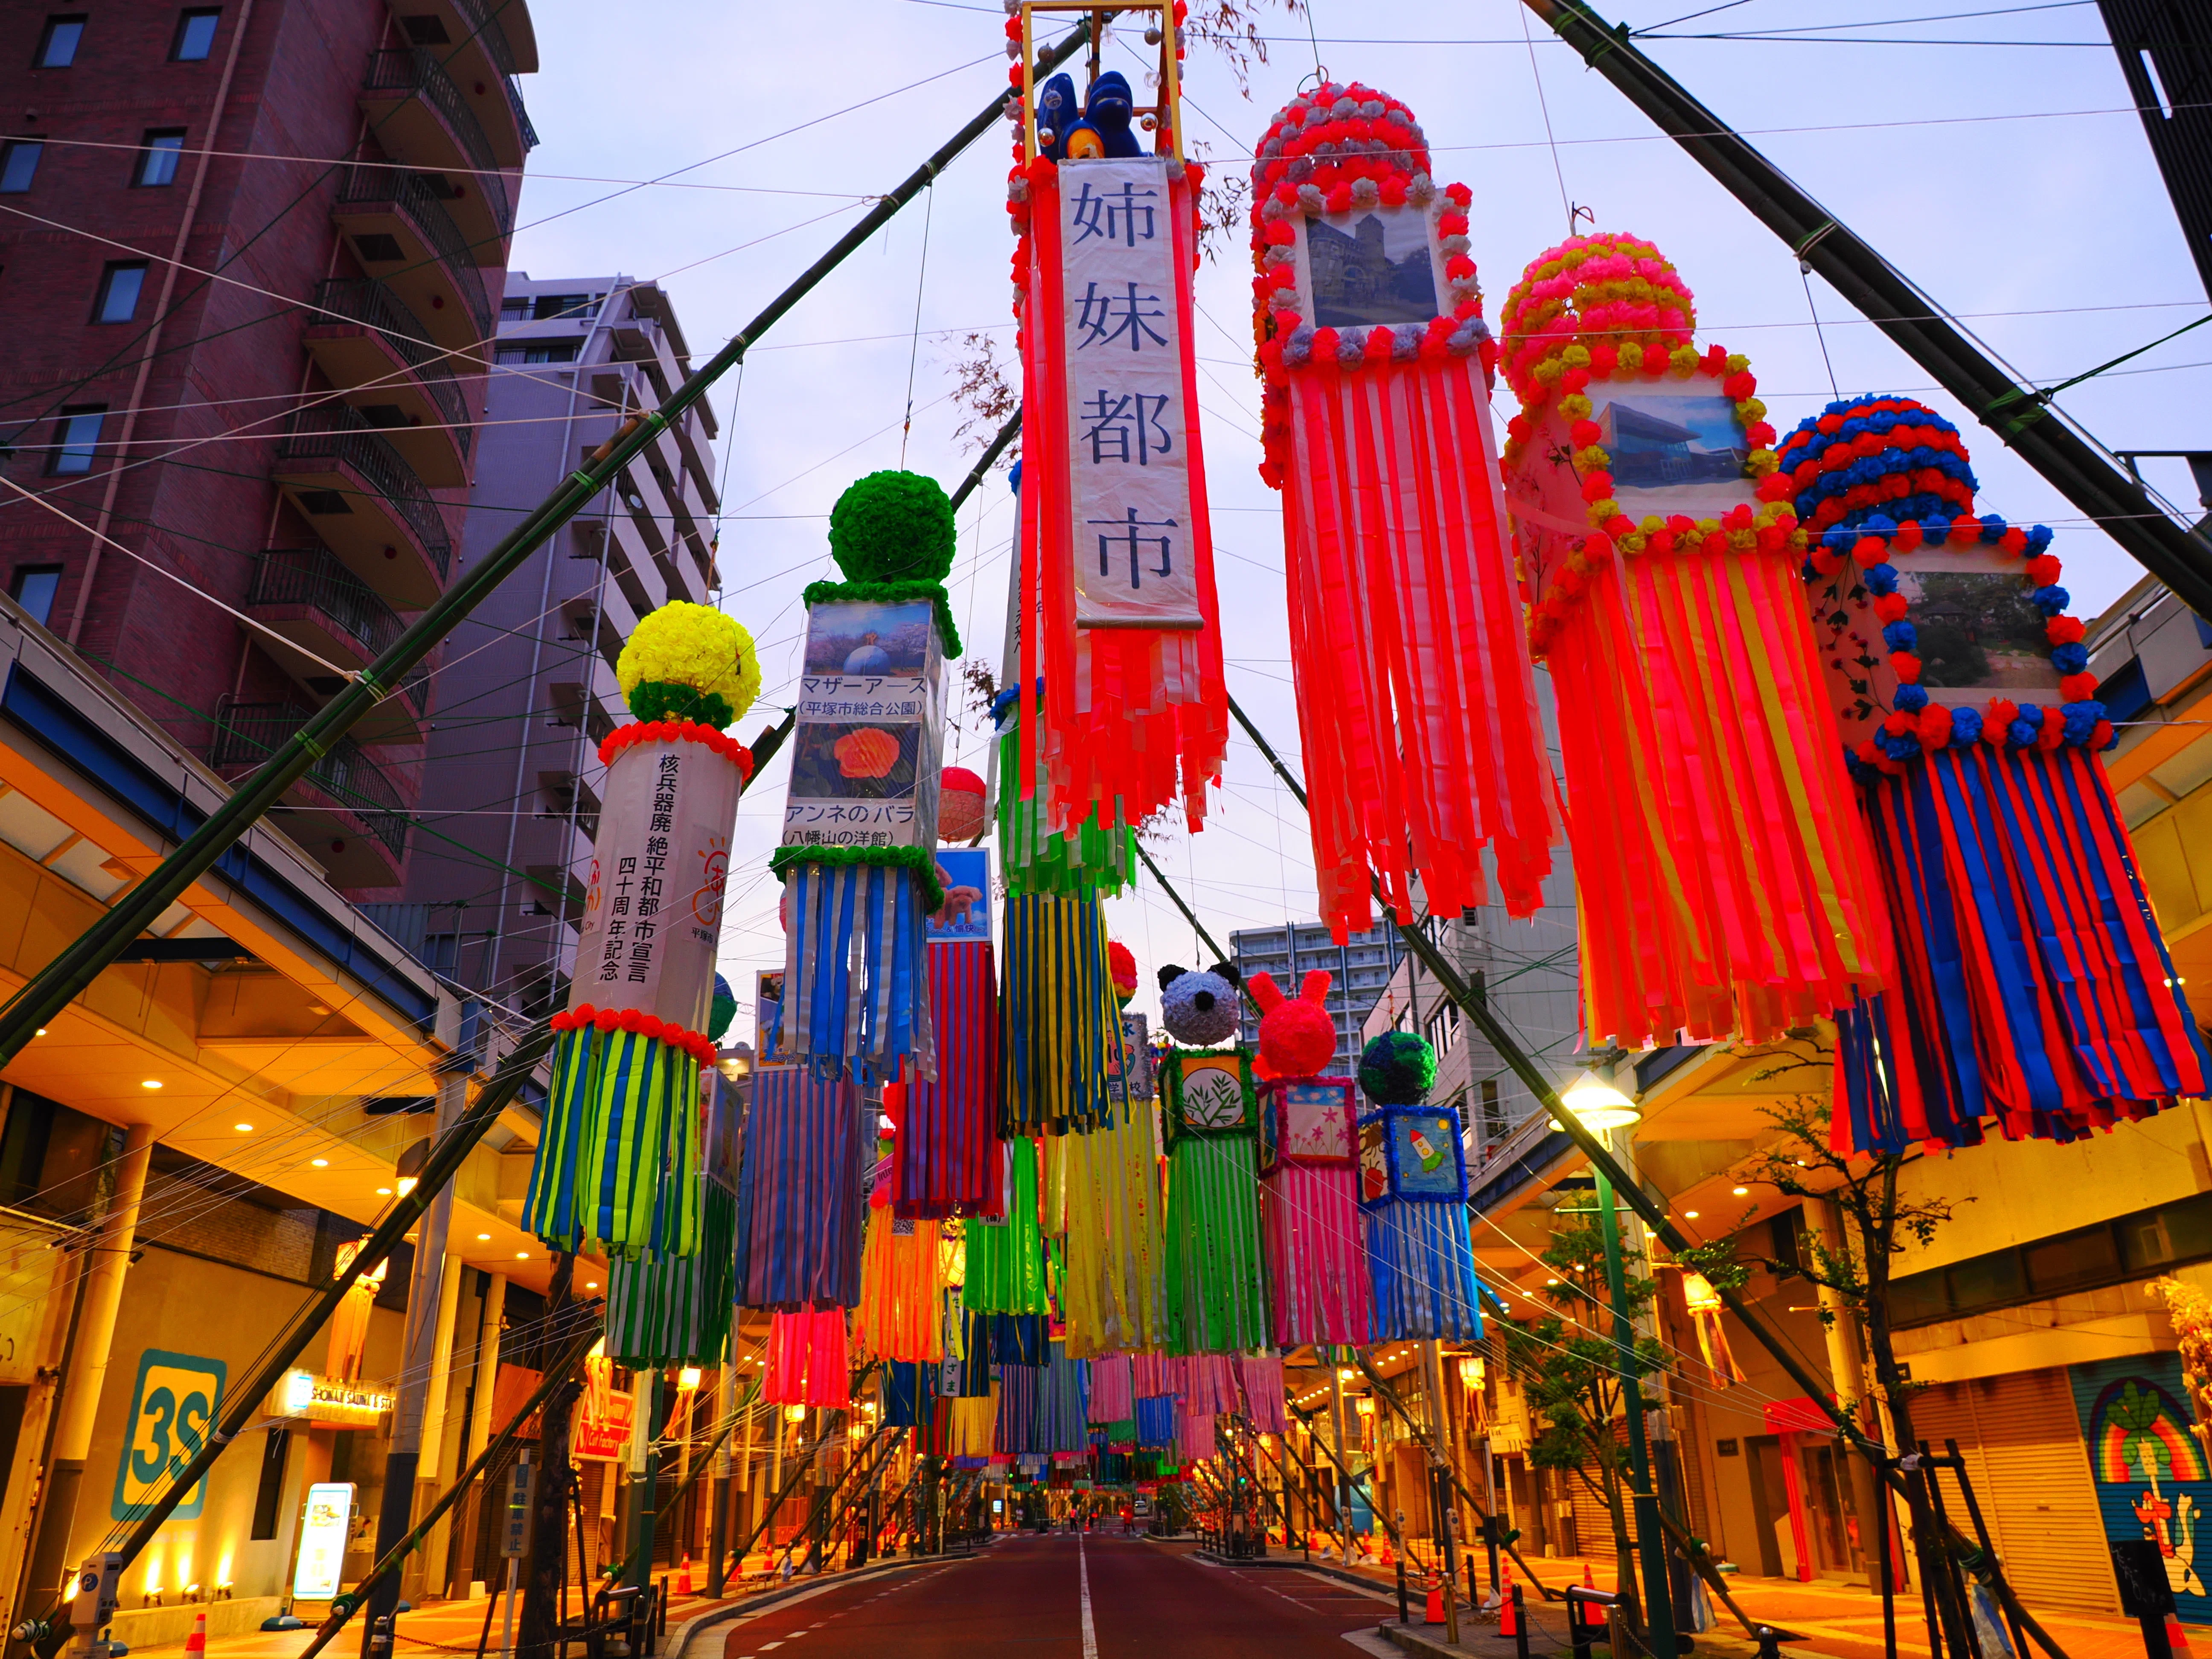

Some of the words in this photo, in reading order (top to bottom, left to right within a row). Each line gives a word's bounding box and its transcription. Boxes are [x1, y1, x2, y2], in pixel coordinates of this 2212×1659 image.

[1071, 182, 1179, 590] 姉妹都市
[800, 700, 923, 716] (平塚市総合公園)
[803, 677, 926, 695] マザーアース
[600, 857, 637, 981] 四十周年記念
[955, 924, 974, 933] 愉快
[132, 1386, 209, 1487] 3S
[509, 1492, 527, 1551] 駐車禁止
